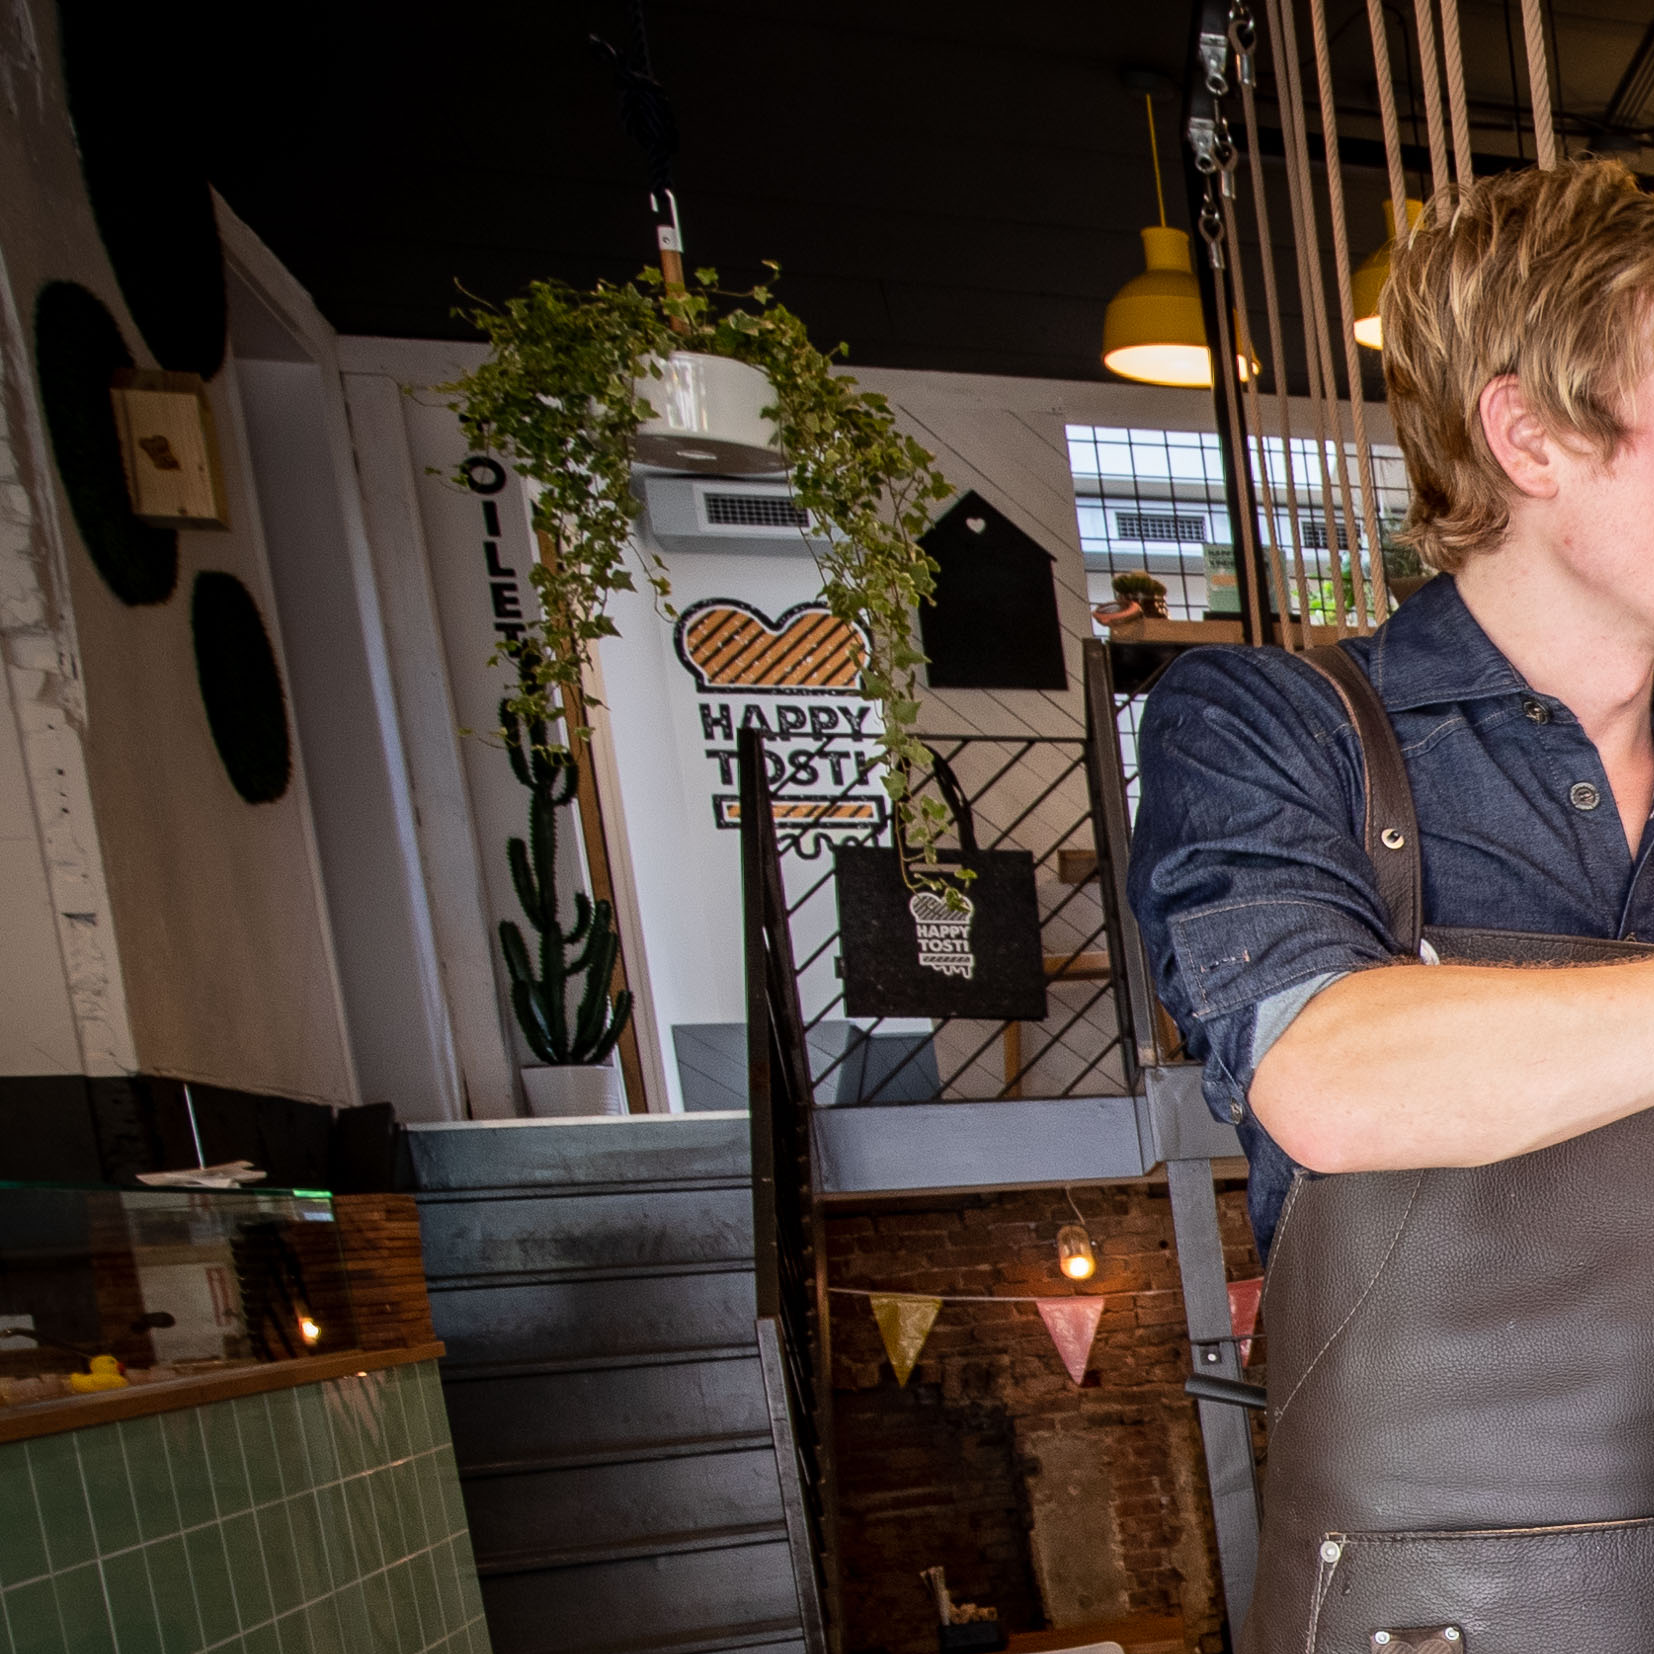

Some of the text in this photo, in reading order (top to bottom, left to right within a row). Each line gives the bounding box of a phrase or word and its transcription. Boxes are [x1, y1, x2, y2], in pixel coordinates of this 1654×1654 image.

[459, 413, 527, 659] OILET
[699, 703, 871, 741] HAPPY
[916, 925, 971, 938] HAPPY
[917, 939, 969, 952] TOSTI
